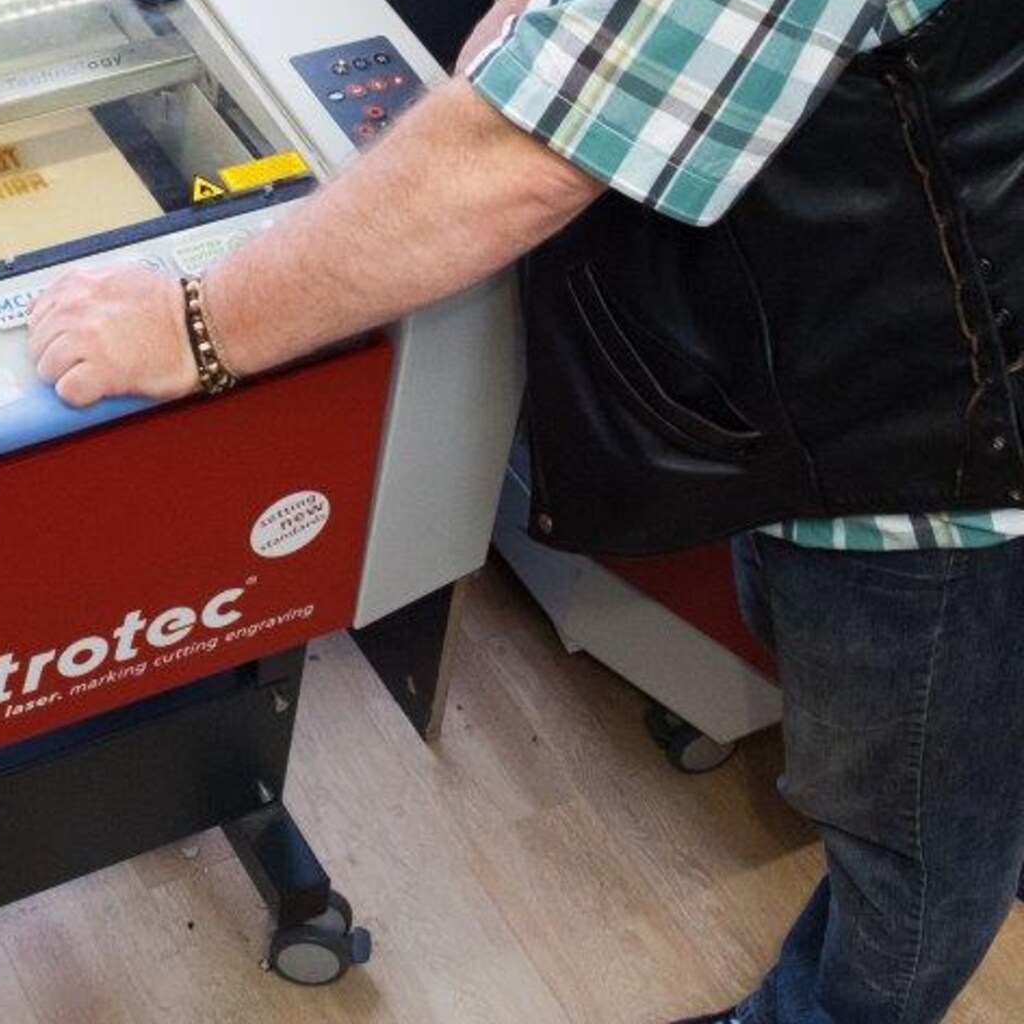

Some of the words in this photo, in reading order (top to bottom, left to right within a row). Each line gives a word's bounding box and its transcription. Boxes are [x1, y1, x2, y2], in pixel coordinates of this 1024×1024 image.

[279, 501, 323, 530] new
[4, 691, 63, 718] laser.
[69, 662, 147, 696] marking
[153, 636, 219, 668] cutting
[225, 603, 315, 643] engraving
